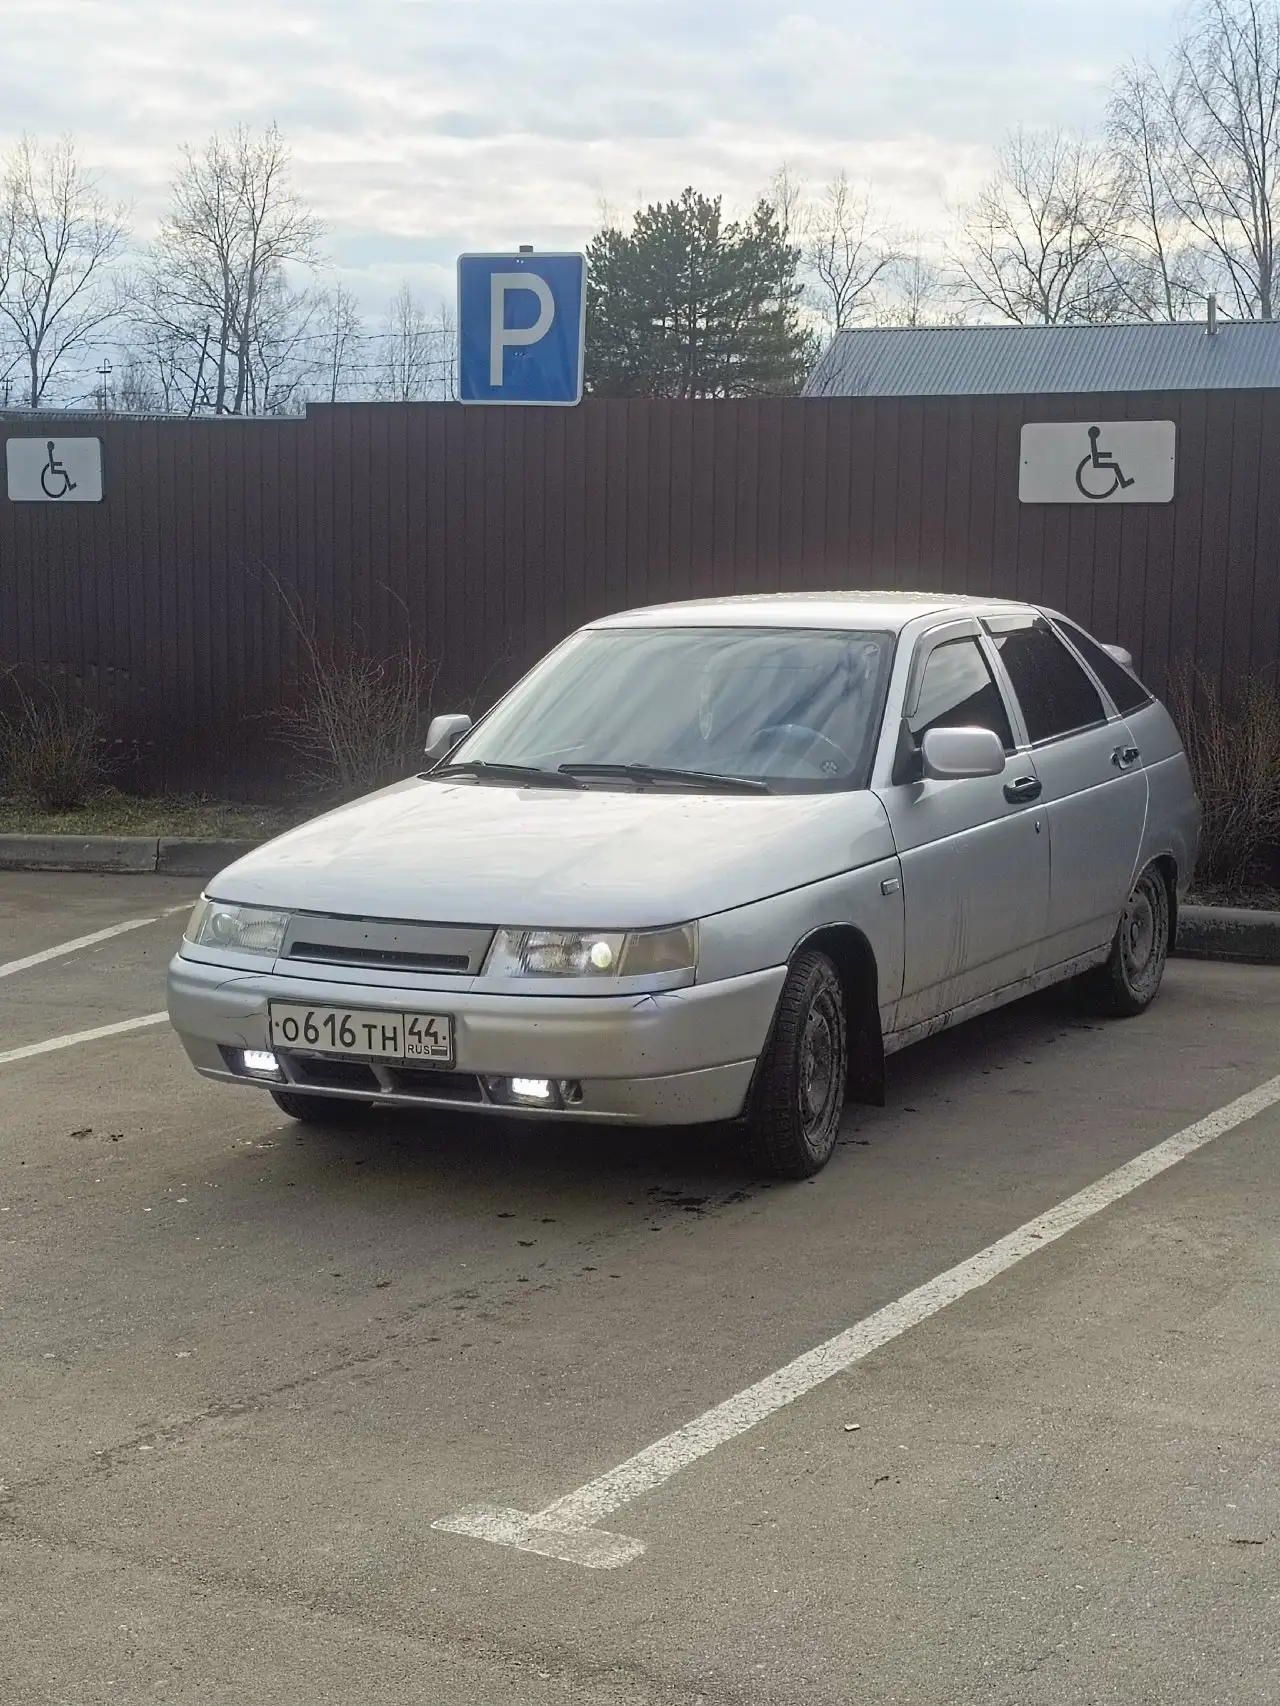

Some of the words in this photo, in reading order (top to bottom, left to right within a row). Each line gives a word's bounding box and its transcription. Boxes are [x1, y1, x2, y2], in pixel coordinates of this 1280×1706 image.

[490, 273, 555, 386] P
[408, 1017, 439, 1045] 44
[407, 1044, 430, 1055] RUS
